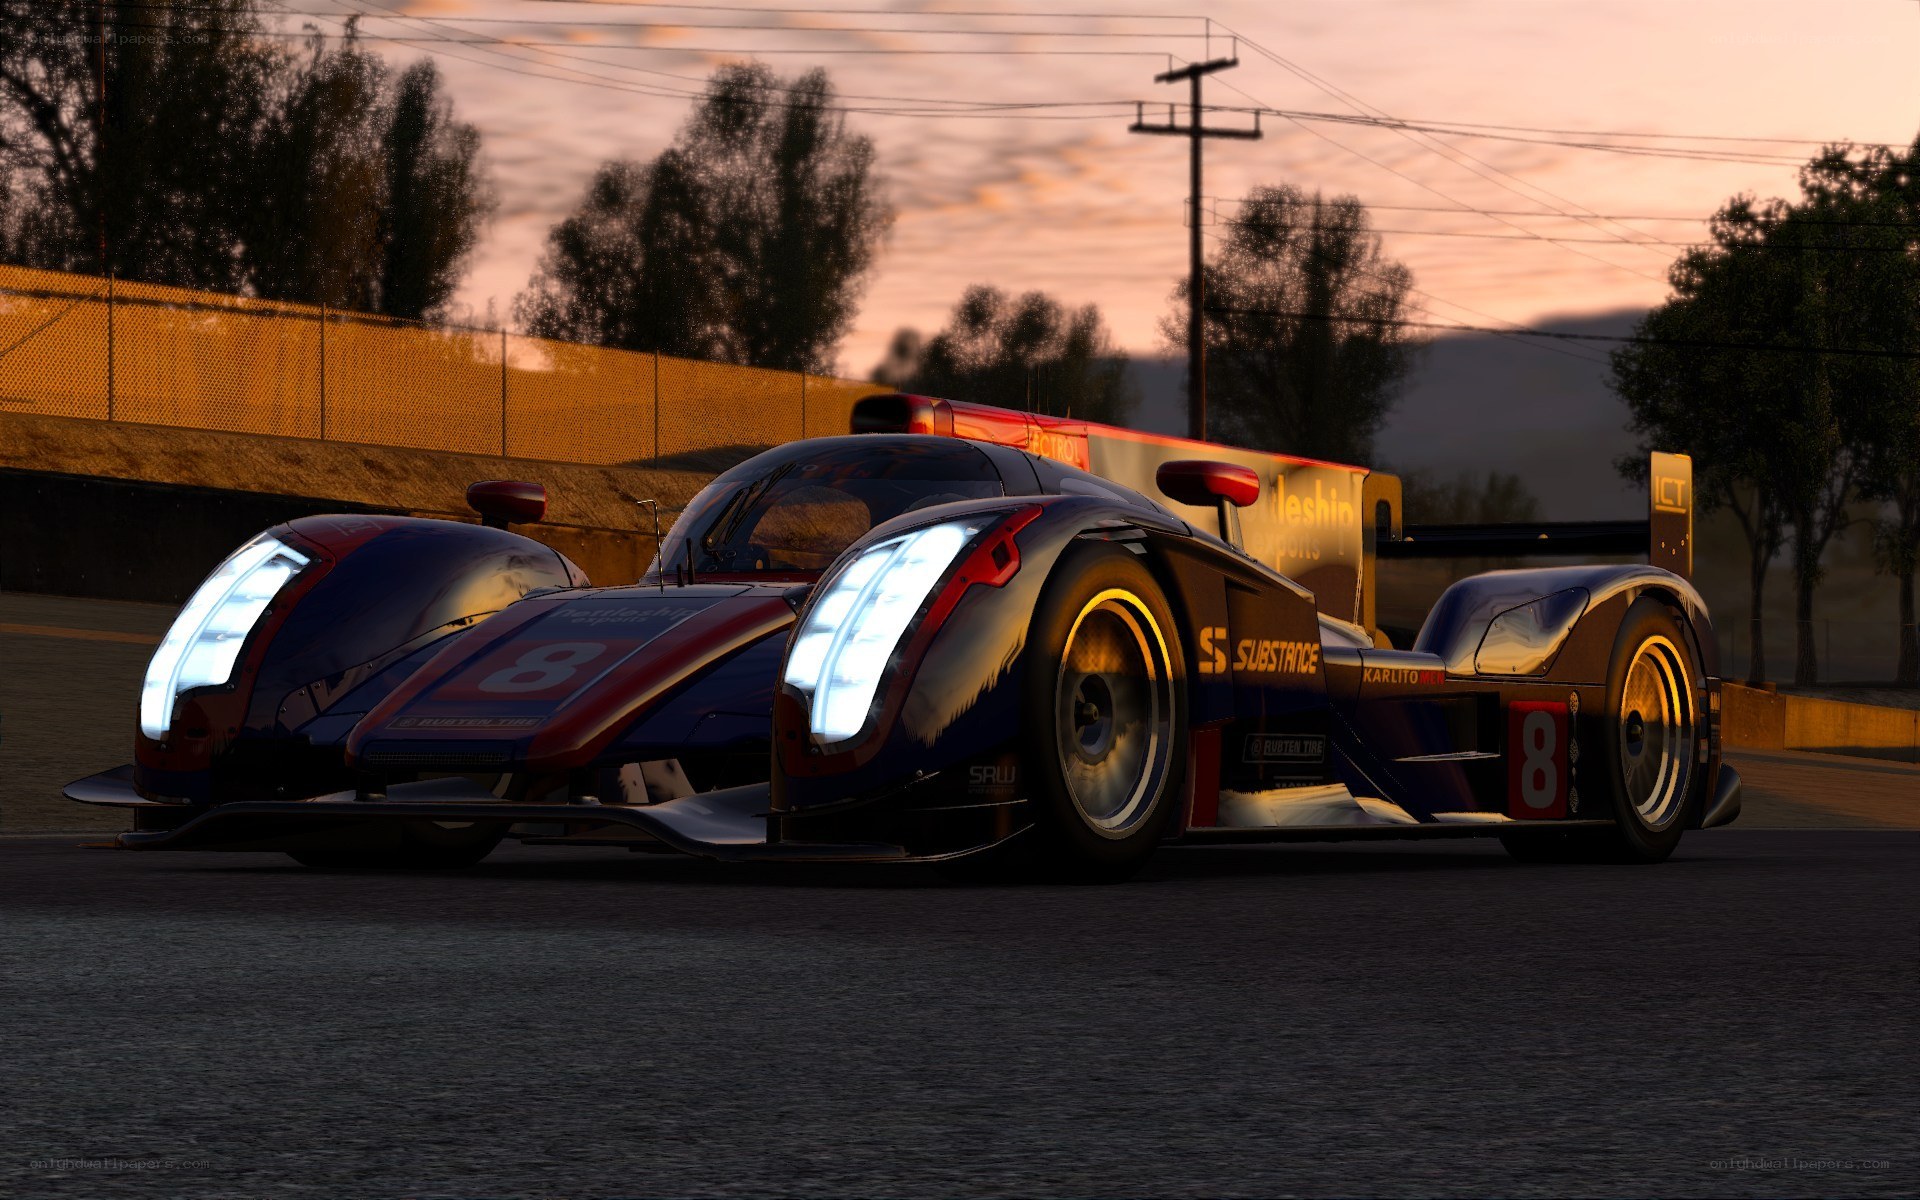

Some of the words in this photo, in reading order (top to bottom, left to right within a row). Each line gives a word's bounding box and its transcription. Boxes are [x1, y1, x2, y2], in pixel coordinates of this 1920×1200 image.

[1655, 475, 1686, 507] ICT
[478, 642, 608, 693] 8
[1232, 638, 1320, 675] SUBSTANCE
[1521, 710, 1558, 809] 8
